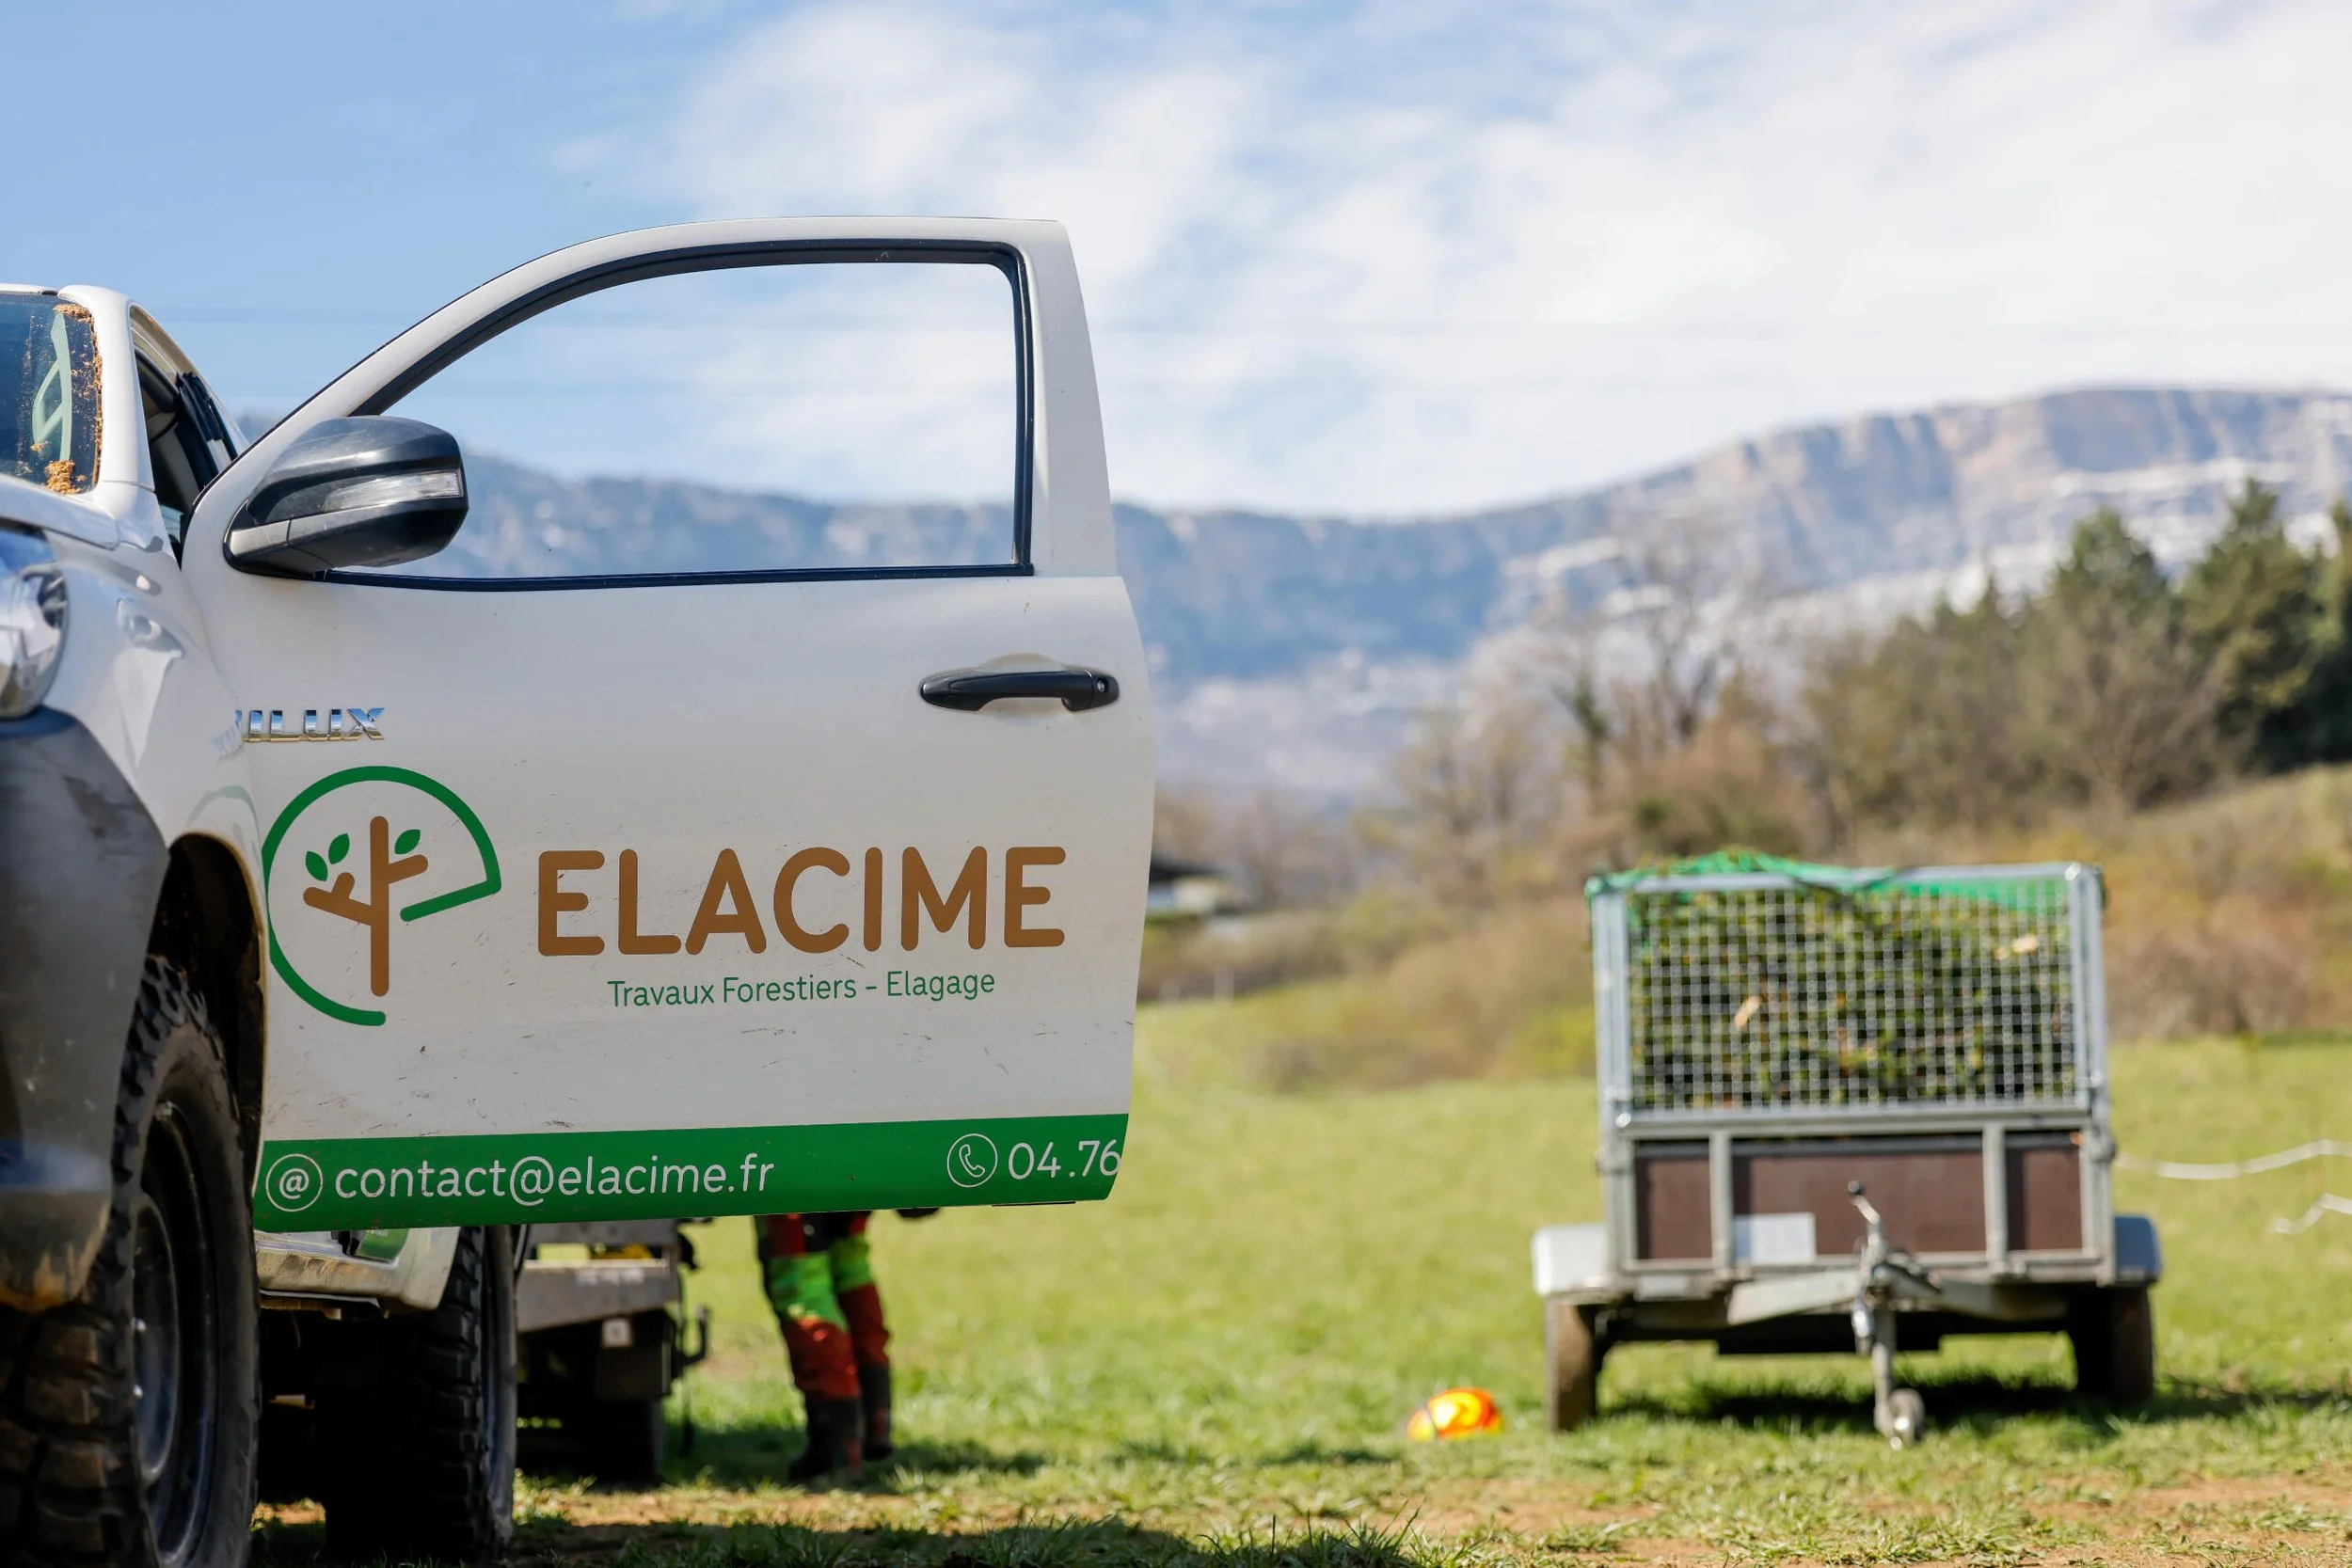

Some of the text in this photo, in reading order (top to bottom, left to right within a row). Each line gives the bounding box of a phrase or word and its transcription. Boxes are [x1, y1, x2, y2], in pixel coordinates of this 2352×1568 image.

[235, 707, 385, 742] ILUX
[537, 846, 1067, 957] ELACIME
[607, 979, 715, 1007] Travaux
[723, 974, 857, 1003] Forestiers
[886, 970, 995, 1002] Elagage
[335, 1152, 775, 1207] contact@elacime.fr
[1008, 1139, 1121, 1180] 04.76
